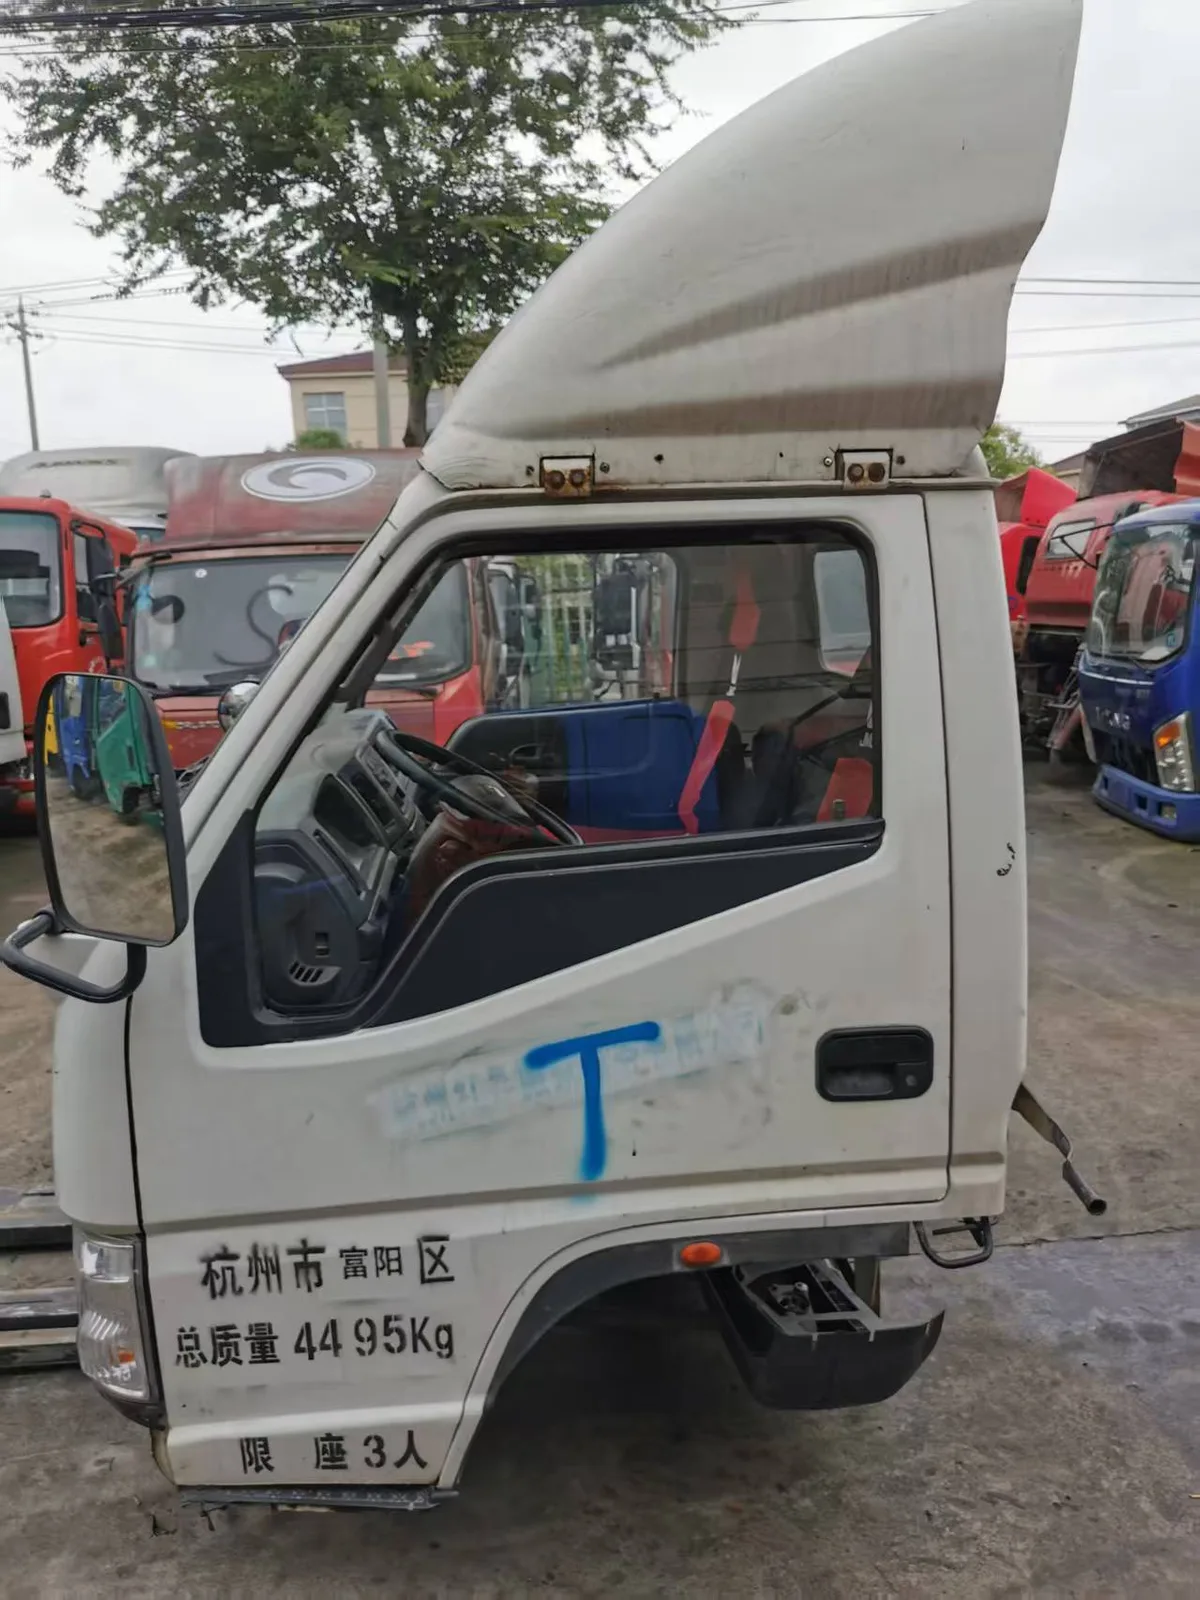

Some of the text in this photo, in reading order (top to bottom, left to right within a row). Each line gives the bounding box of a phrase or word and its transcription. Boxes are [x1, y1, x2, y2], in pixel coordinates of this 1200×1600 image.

[524, 1021, 662, 1179] T
[200, 1235, 455, 1300] 杭州市富阳区
